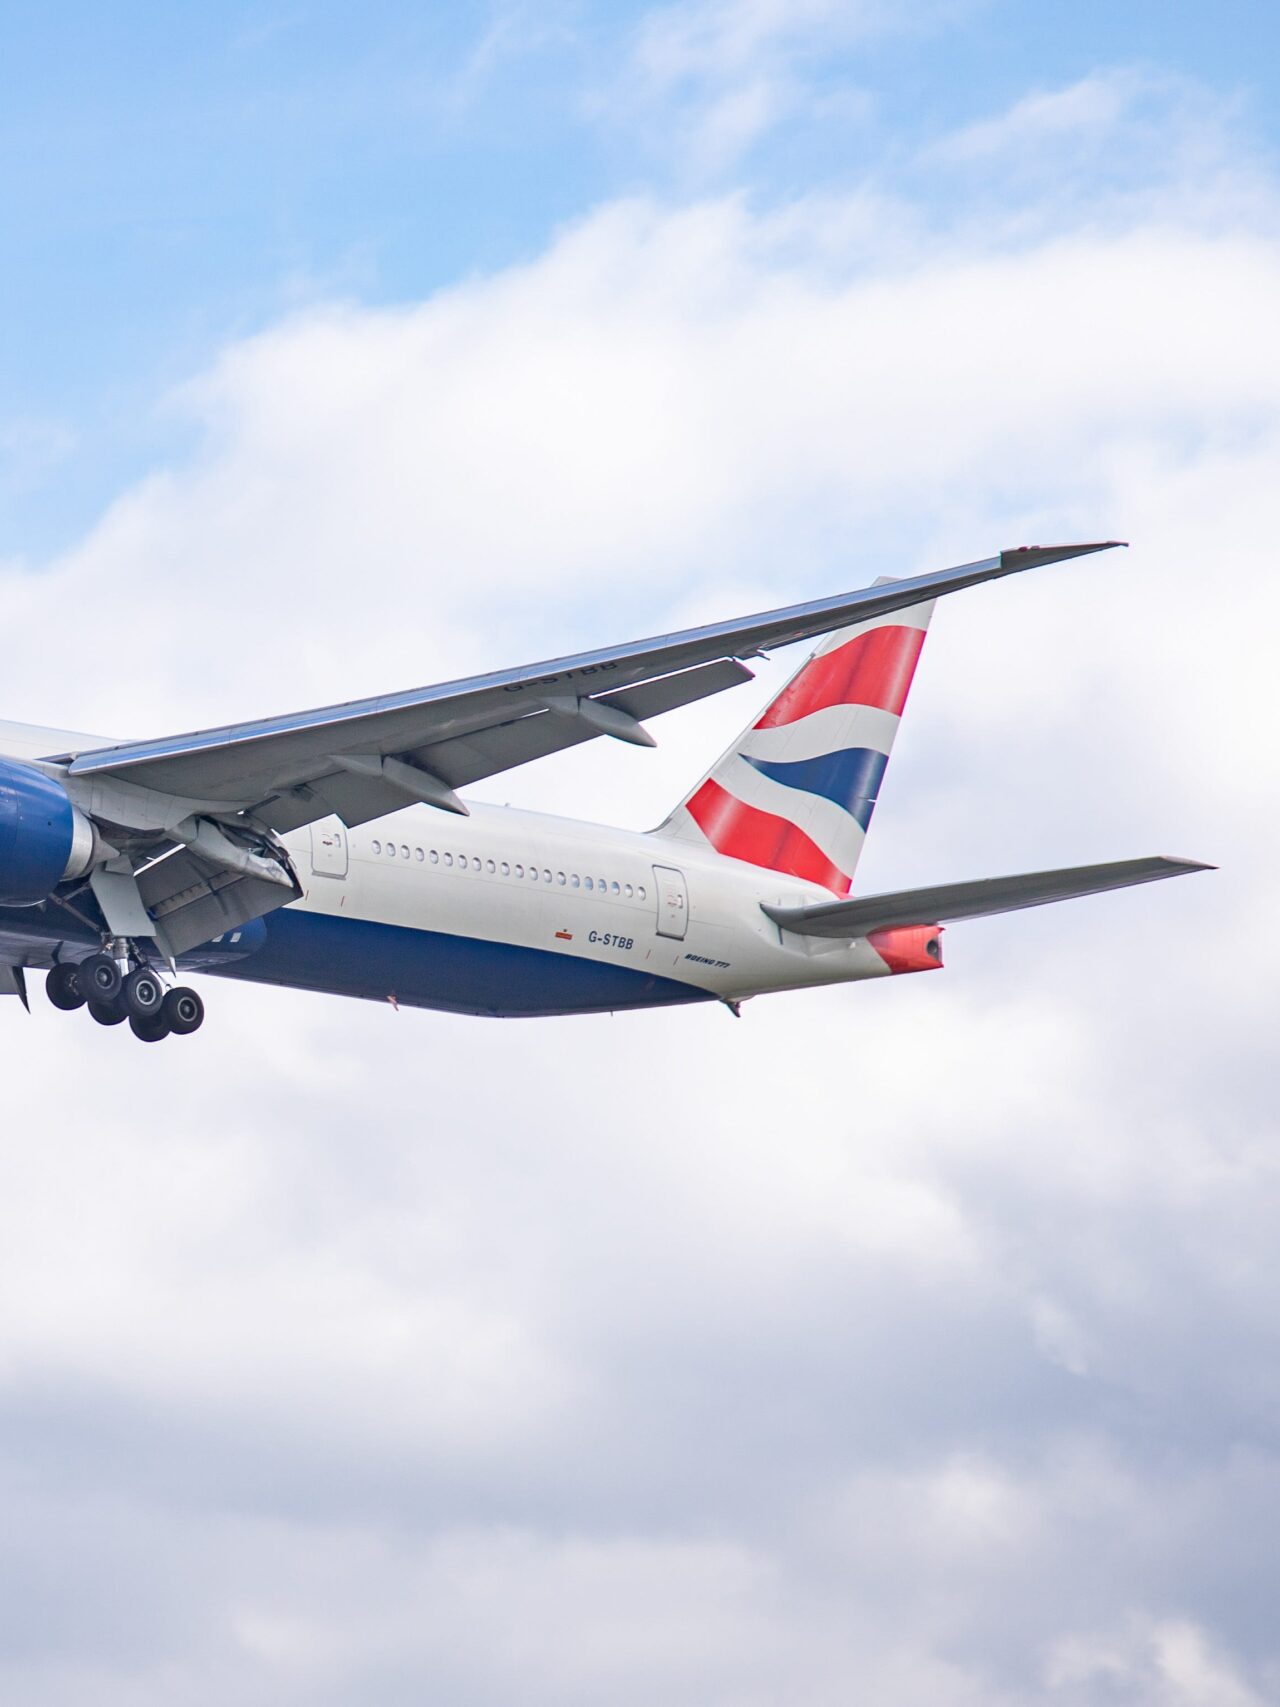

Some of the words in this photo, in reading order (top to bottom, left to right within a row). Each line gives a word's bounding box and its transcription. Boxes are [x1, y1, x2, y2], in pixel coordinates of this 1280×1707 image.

[588, 930, 634, 950] G-STBB
[684, 953, 716, 965] BOEING
[714, 960, 731, 969] 777
